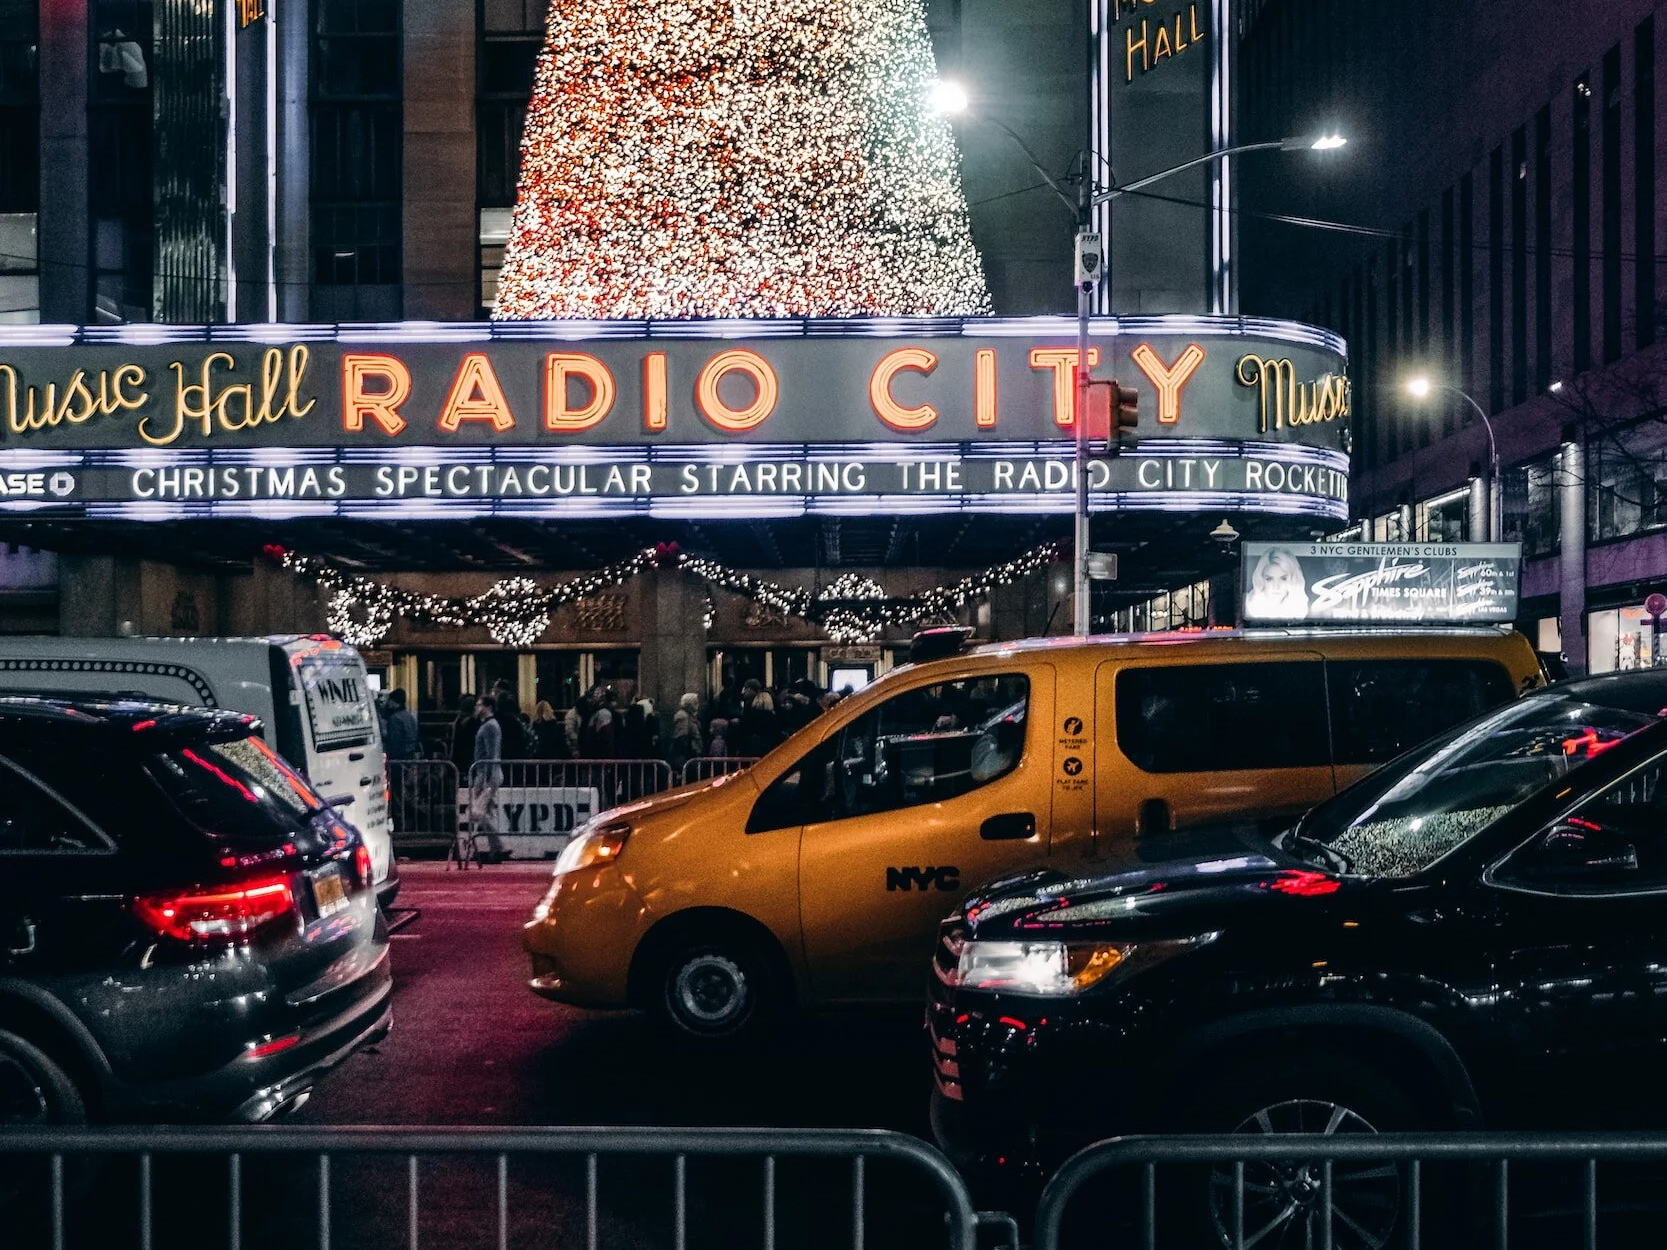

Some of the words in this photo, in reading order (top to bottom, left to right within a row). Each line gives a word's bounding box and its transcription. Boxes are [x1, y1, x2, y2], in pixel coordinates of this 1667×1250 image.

[1125, 3, 1206, 82] HALL
[138, 344, 317, 446] Hall
[341, 348, 779, 436] RADIO
[869, 341, 1205, 432] CITY
[132, 465, 347, 498] CHRISTMAS
[374, 463, 653, 497] SPECTACULAR
[680, 462, 867, 494] STARRING
[900, 461, 963, 491] THE
[994, 459, 1110, 490] RADIO
[1138, 458, 1221, 489] CITY
[1310, 545, 1317, 555] 3
[1320, 545, 1344, 555] NYC
[1347, 545, 1420, 556] GENTLEMEN'S
[1423, 546, 1458, 557] CLUBS
[1311, 555, 1431, 612] Sapphire
[1371, 587, 1401, 598] TIMES
[1403, 587, 1448, 598] SQUARE
[480, 803, 574, 832] YPD
[886, 866, 960, 891] NYC
